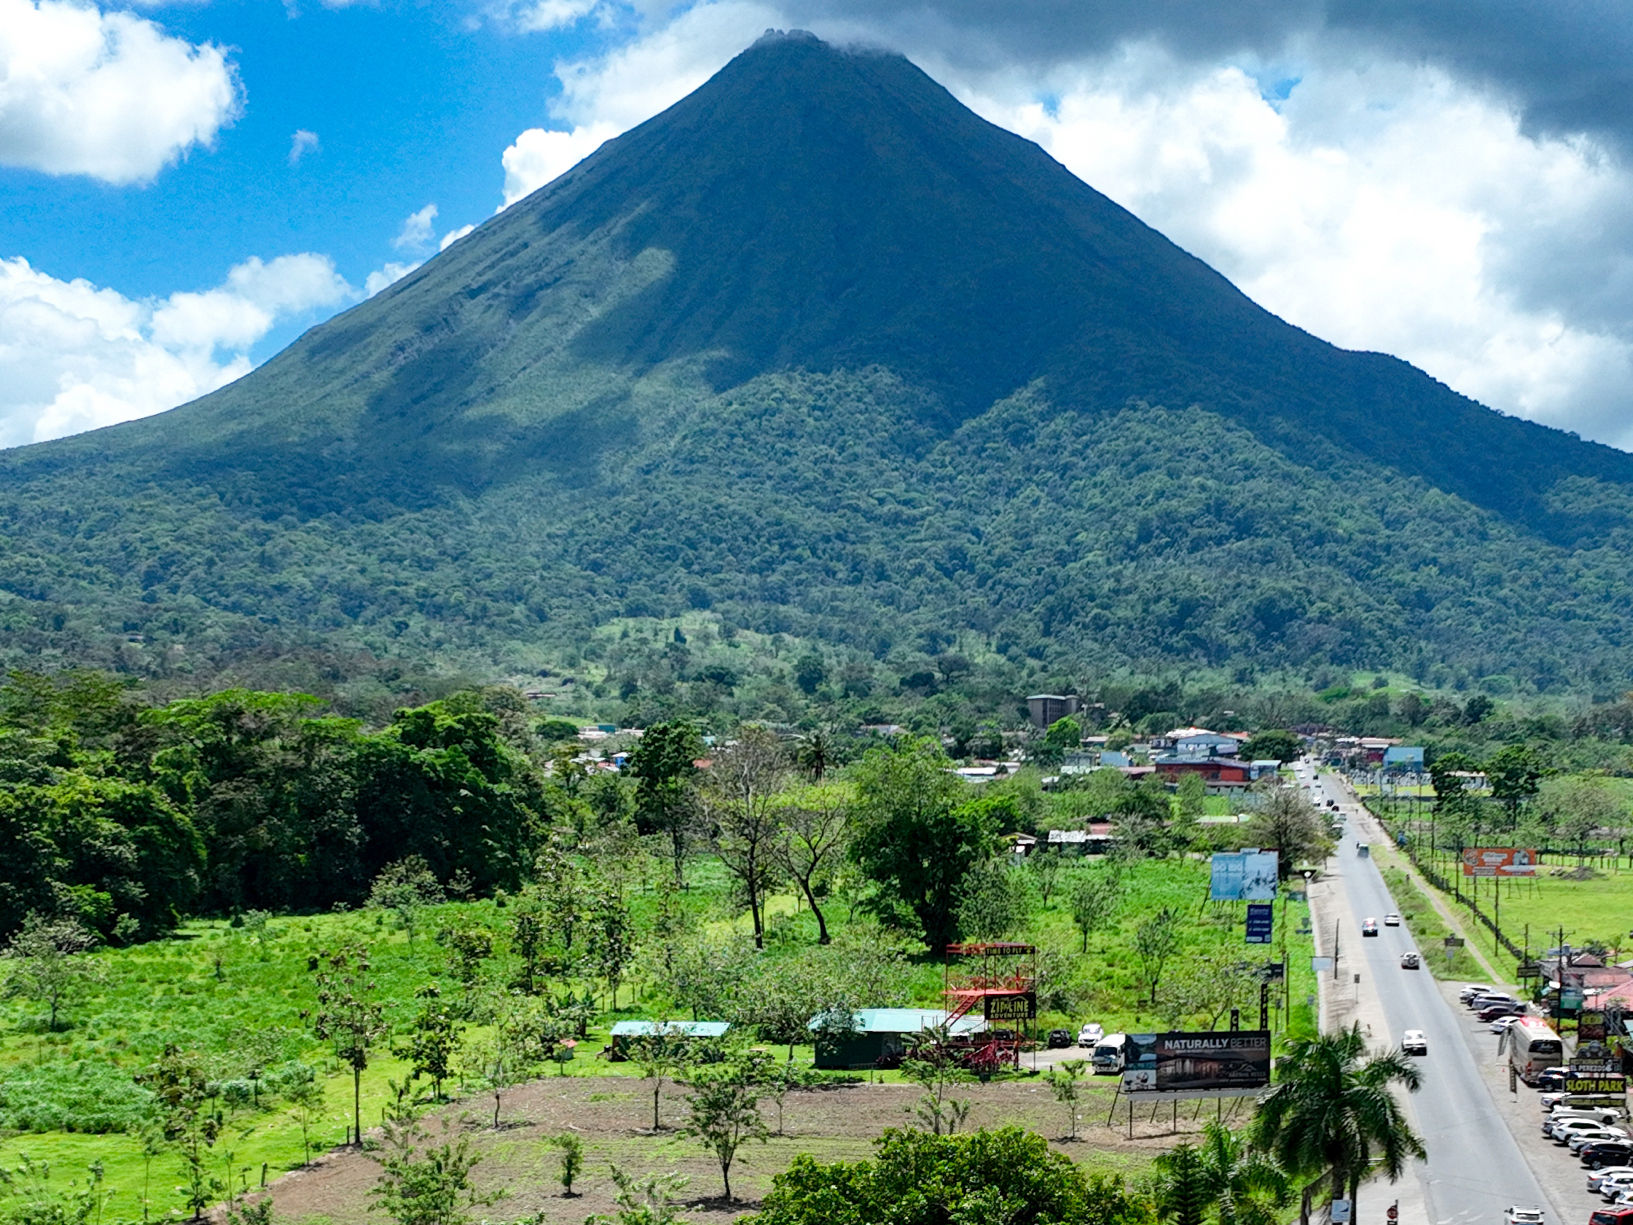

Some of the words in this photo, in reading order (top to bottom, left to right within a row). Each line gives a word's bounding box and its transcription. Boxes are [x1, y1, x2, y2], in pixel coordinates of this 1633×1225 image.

[1164, 1038, 1229, 1050] NATURALLY
[1230, 1037, 1267, 1048] BETTER
[1566, 1080, 1595, 1091] SLOTH
[1598, 1081, 1624, 1091] PARK
